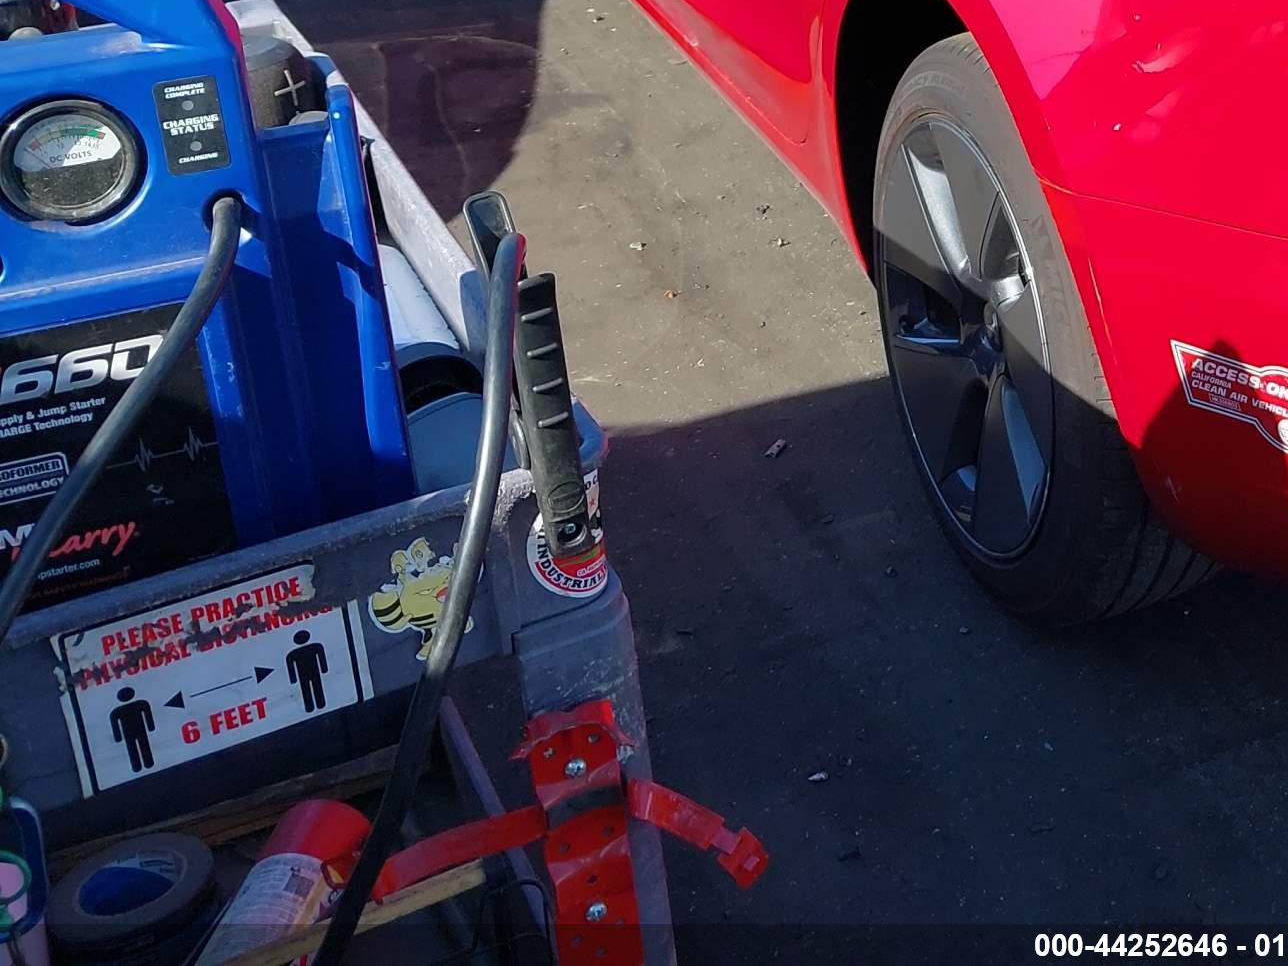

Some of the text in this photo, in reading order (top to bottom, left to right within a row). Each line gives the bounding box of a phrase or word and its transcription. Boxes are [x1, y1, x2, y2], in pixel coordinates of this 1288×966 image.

[163, 113, 219, 130] CHARGING
[170, 121, 215, 136] STATUS
[50, 151, 93, 164] DC VOLTS
[178, 151, 219, 164] CHARGING
[1191, 358, 1260, 389] ACCESS
[1191, 372, 1232, 389] CALIFORNIA
[1191, 380, 1228, 397] CLEAN
[1229, 391, 1249, 404] AIR
[0, 397, 107, 428] pply & Jump Starter
[34, 412, 94, 431] Technology
[0, 460, 61, 482] OFORMER
[49, 522, 136, 557] arry
[101, 575, 302, 656] PLEASE PRACTICE
[181, 697, 268, 745] 6 FEET
